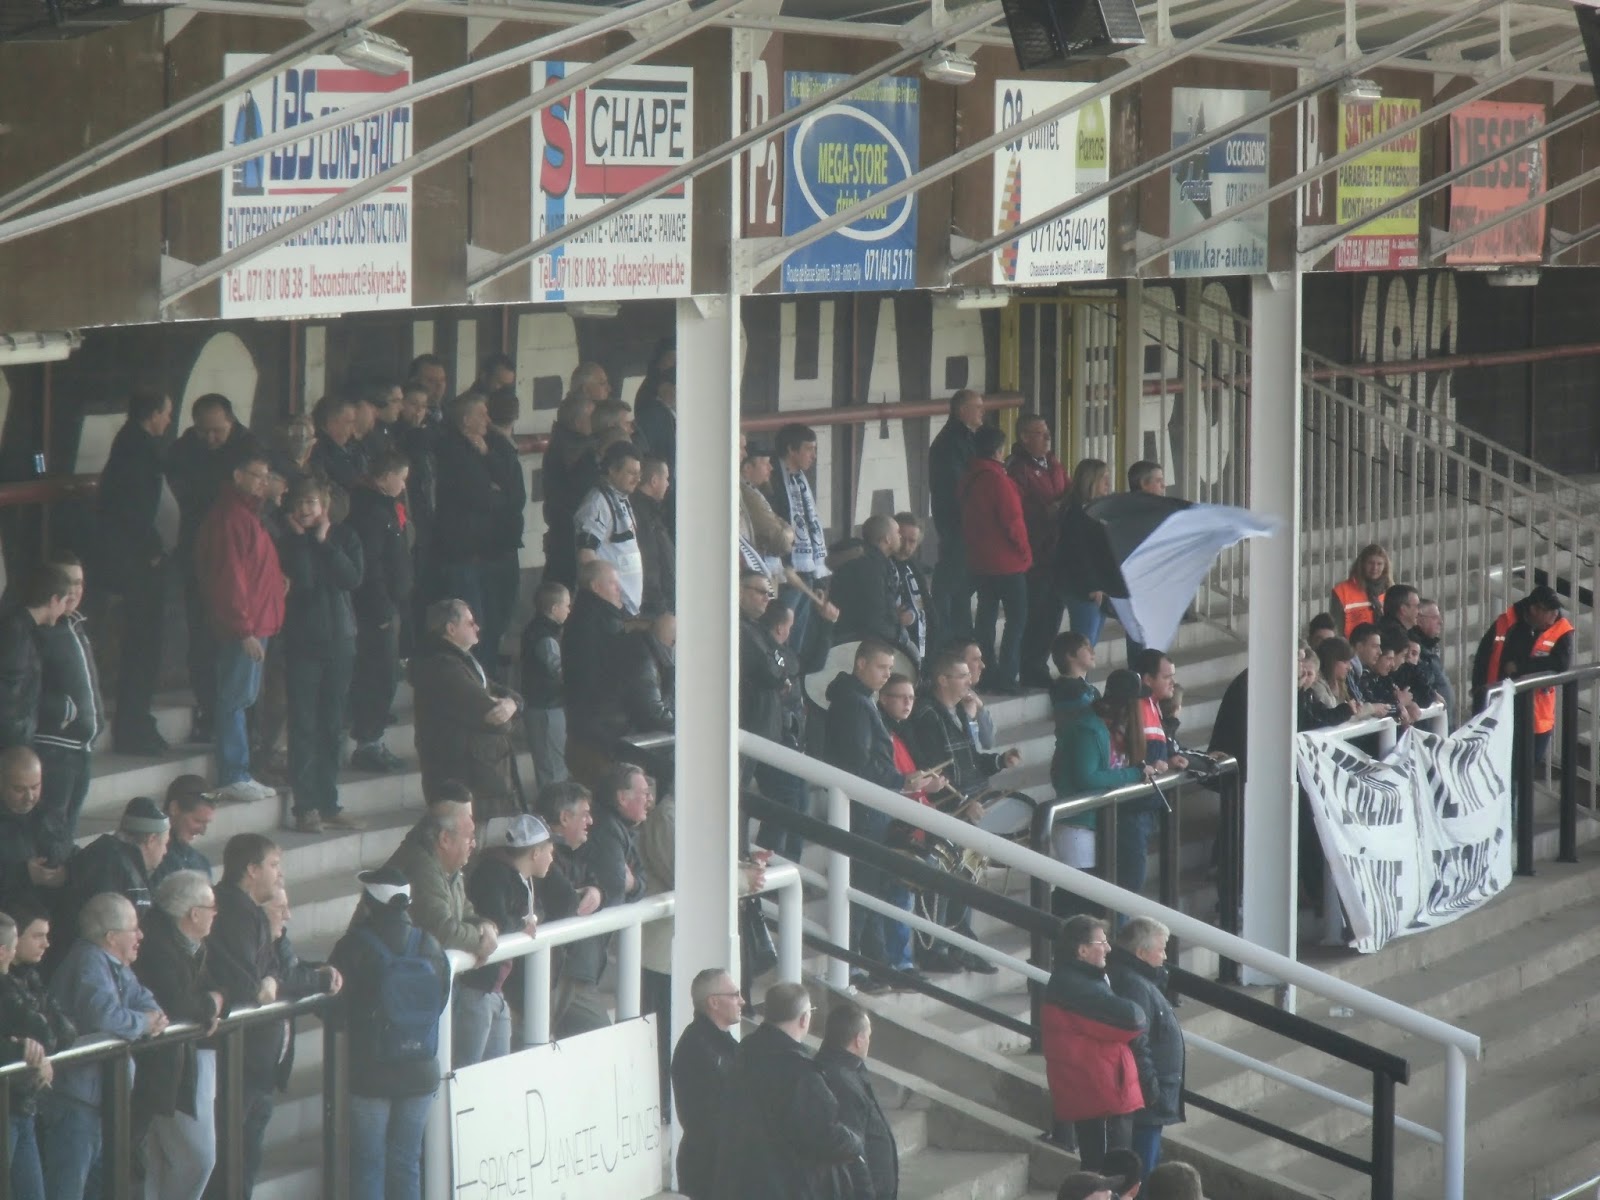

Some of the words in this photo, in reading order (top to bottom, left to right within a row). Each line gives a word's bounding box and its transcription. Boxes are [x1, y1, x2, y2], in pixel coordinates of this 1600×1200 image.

[590, 95, 686, 158] CHAPE
[818, 143, 888, 184] MEGA-STORE
[1226, 140, 1265, 166] OCCASIONS
[343, 203, 407, 244] CONSTRUCTION
[609, 213, 653, 243] CARRELAGE
[658, 213, 686, 242] PAVAGE
[1030, 217, 1106, 253] 071/35/40/13
[1174, 241, 1265, 270] www.kar-auto.be
[279, 268, 289, 299] 08
[585, 256, 595, 288] 08
[597, 256, 607, 287] 38
